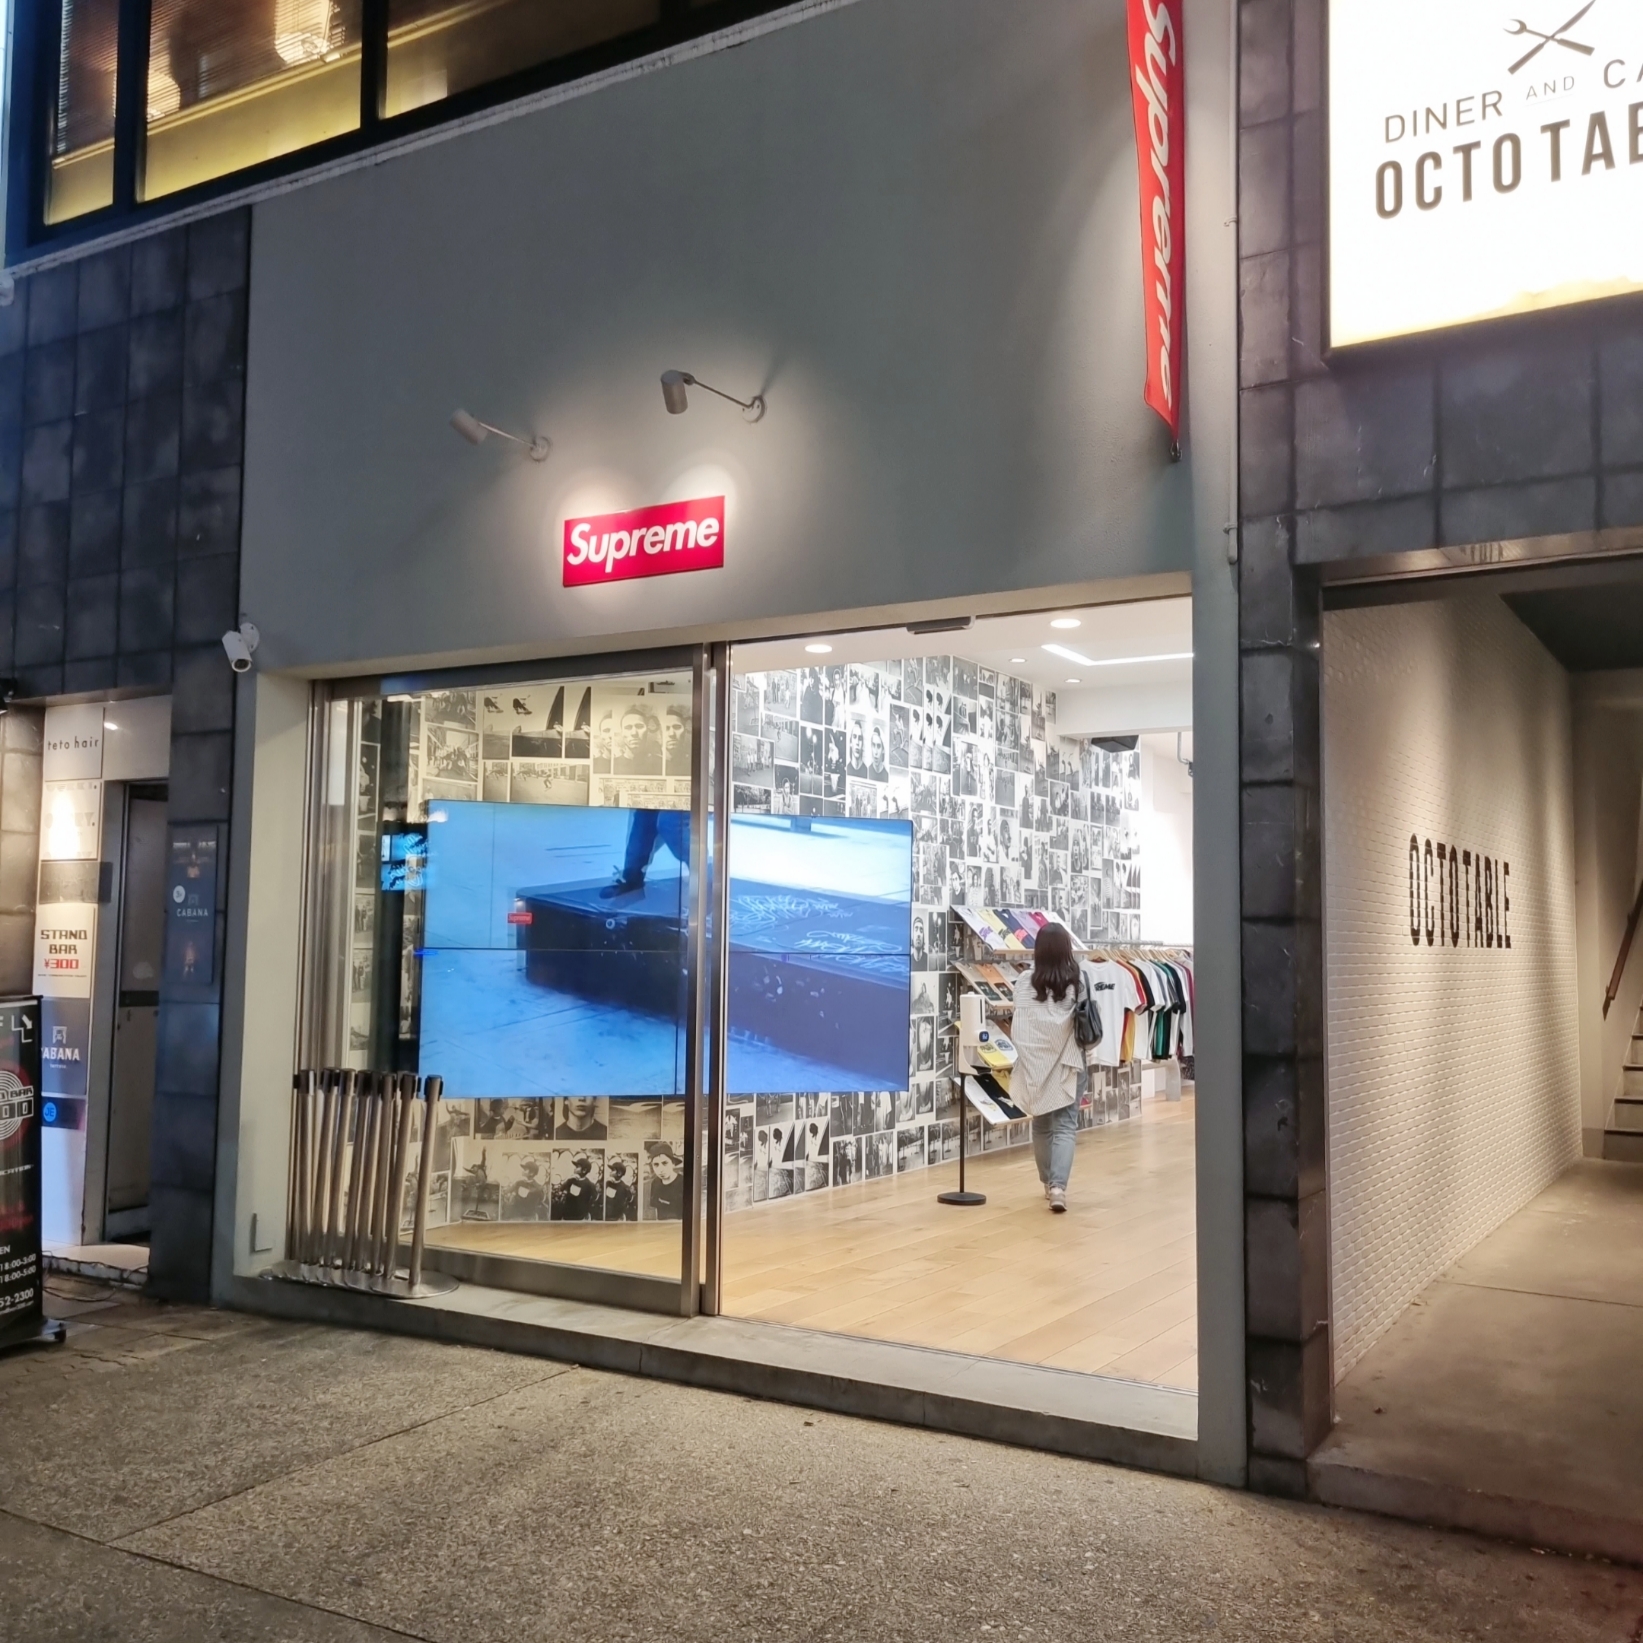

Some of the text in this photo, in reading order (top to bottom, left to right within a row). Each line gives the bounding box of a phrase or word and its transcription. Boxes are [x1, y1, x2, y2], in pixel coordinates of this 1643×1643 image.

[1385, 90, 1503, 143] DINER
[1526, 76, 1575, 100] AND
[1135, 0, 1176, 409] Supreme
[566, 517, 720, 573] Supreme
[47, 736, 99, 750] teto hair
[1409, 833, 1511, 948] OCTOTABLE
[176, 908, 209, 917] CABANA
[41, 929, 88, 940] STAND
[49, 944, 77, 954] BAR
[44, 958, 79, 969] ¥300
[41, 1046, 80, 1061] ABANA
